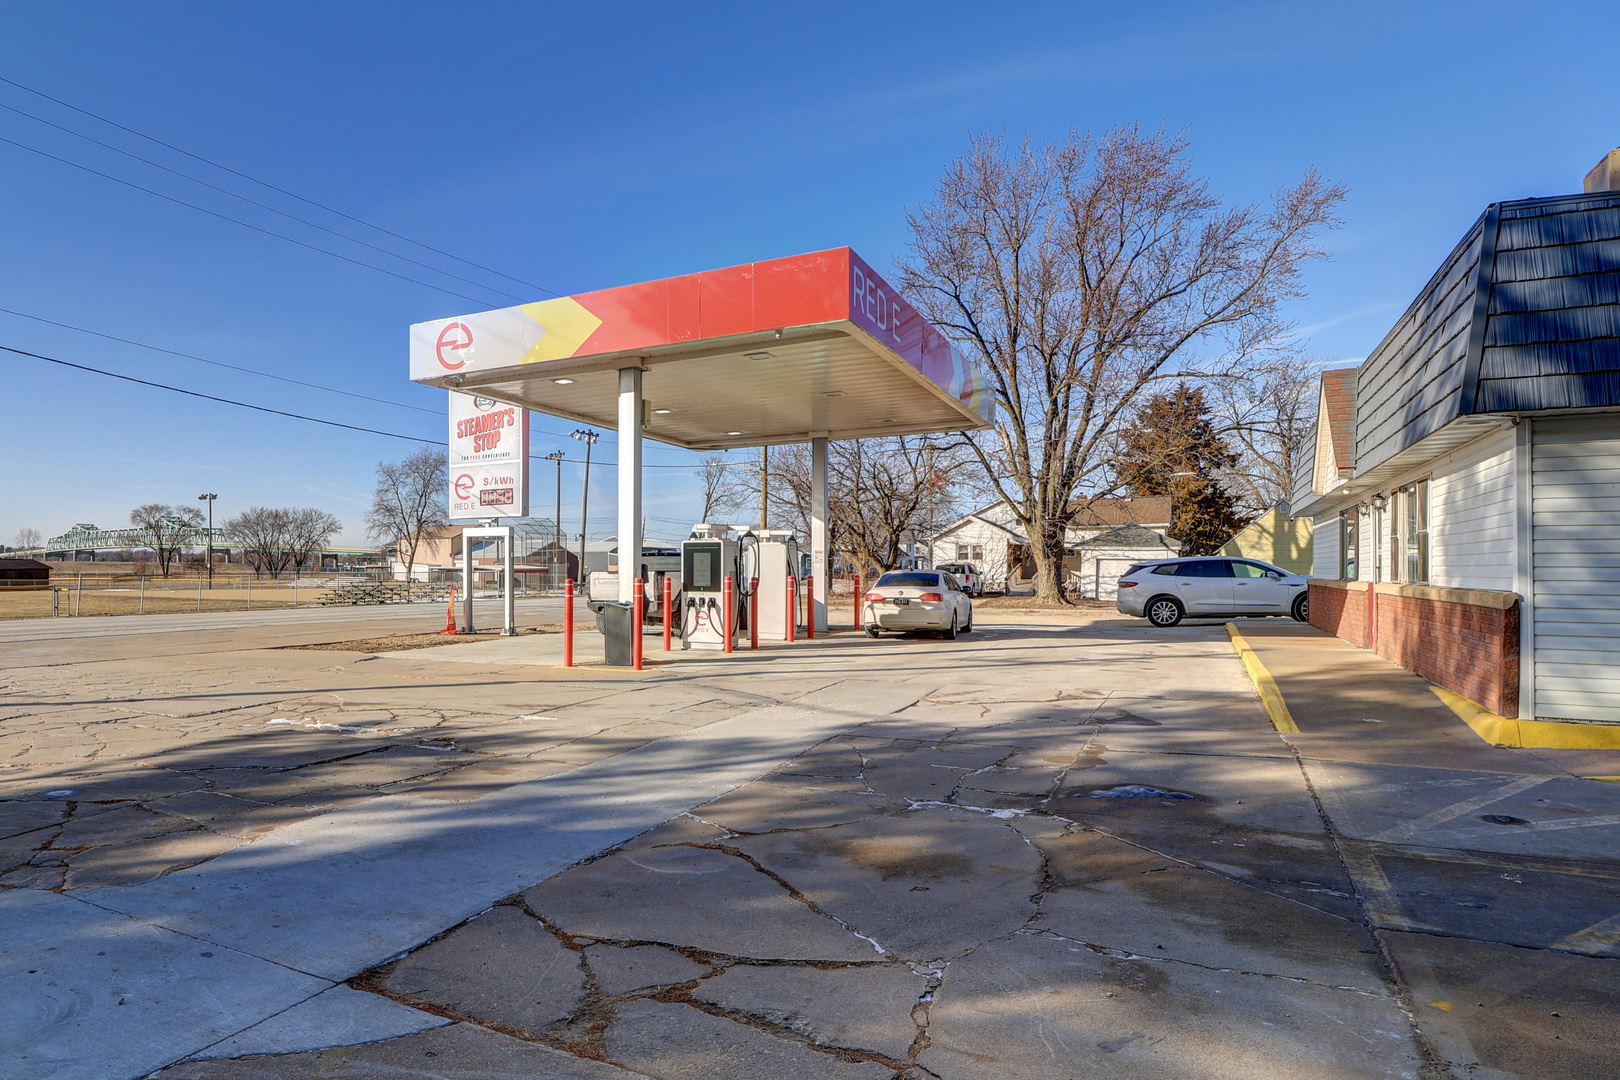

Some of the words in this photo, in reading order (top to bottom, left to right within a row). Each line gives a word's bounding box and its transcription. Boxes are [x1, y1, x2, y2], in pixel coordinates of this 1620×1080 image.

[853, 265, 887, 332] RED
[892, 302, 901, 343] E
[456, 407, 515, 438] STEAMER'S
[473, 430, 501, 453] STOP
[454, 502, 469, 511] RED
[470, 502, 476, 510] E
